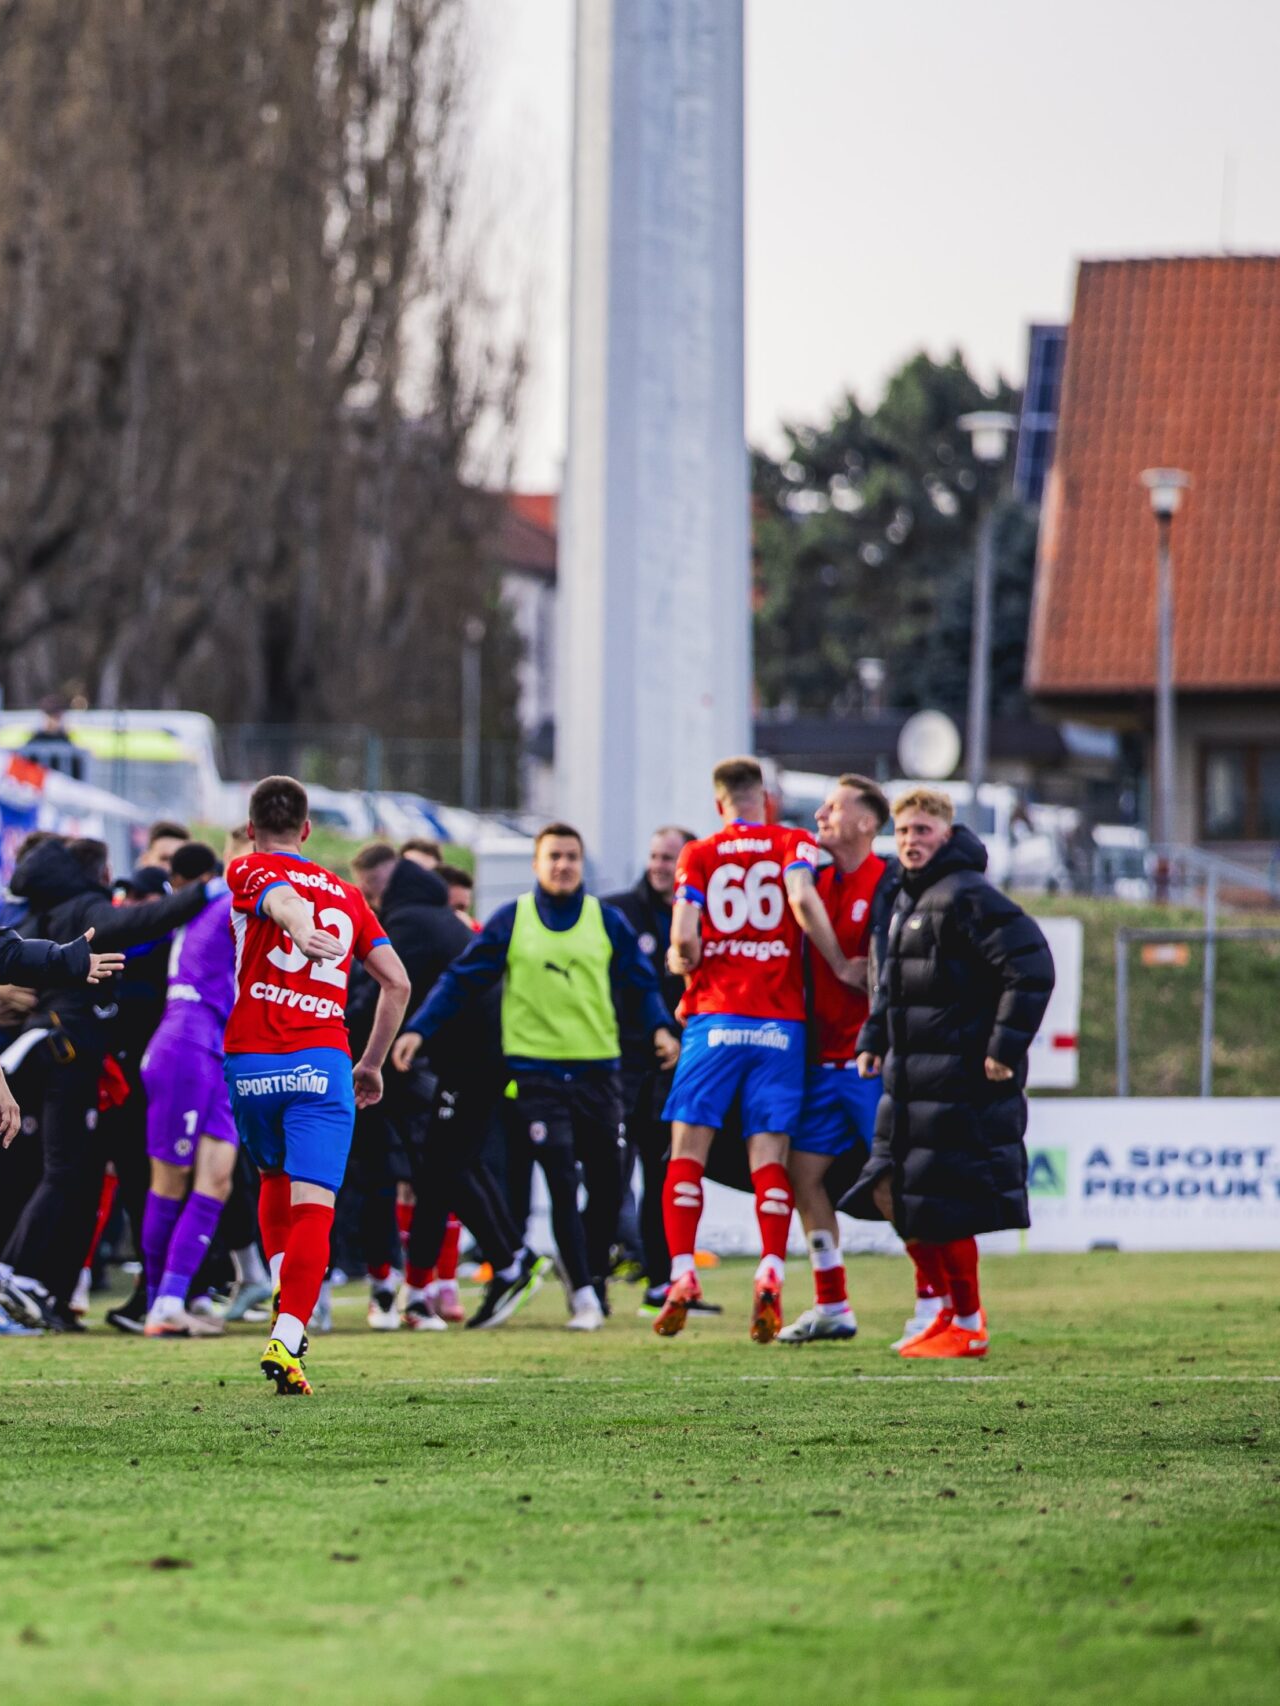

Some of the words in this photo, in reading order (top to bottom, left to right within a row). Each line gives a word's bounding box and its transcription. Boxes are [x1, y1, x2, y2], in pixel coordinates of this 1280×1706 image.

[707, 860, 784, 934] 66
[182, 1109, 199, 1136] 1
[1086, 1148, 1111, 1167] A
[1130, 1148, 1273, 1167] SPORT
